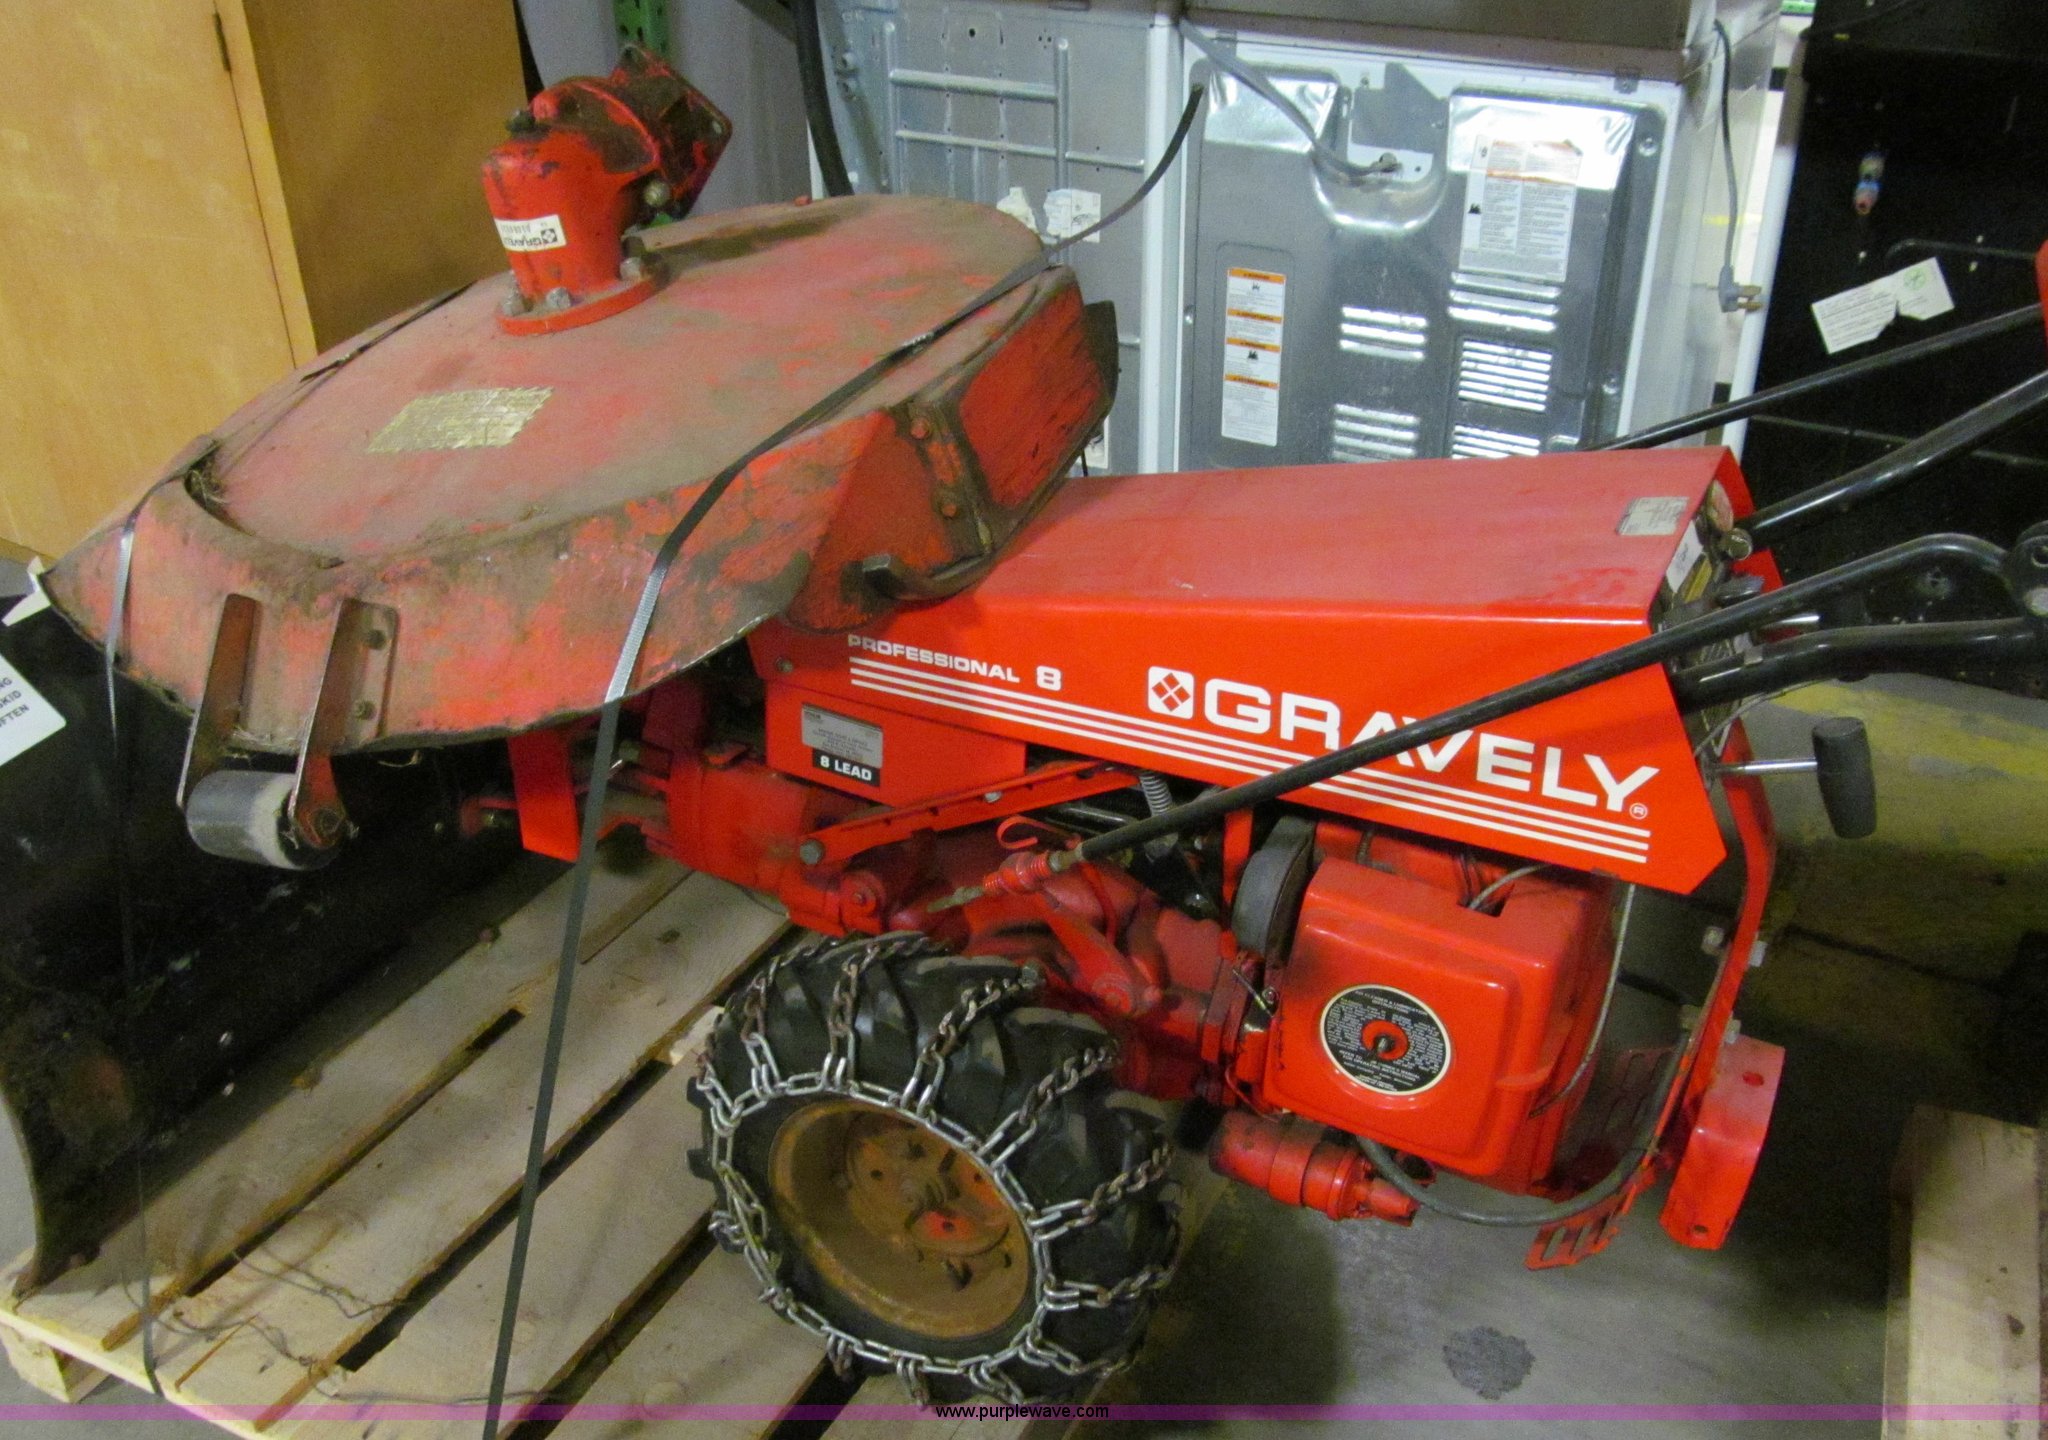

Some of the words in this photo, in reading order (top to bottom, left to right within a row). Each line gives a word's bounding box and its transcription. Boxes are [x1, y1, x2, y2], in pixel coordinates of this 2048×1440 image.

[848, 634, 1019, 683] PROFESSIONAL
[1036, 666, 1062, 692] 8
[0, 704, 30, 727] FTEN
[1205, 678, 1660, 813] GRAVELY
[834, 759, 872, 781] LEAD
